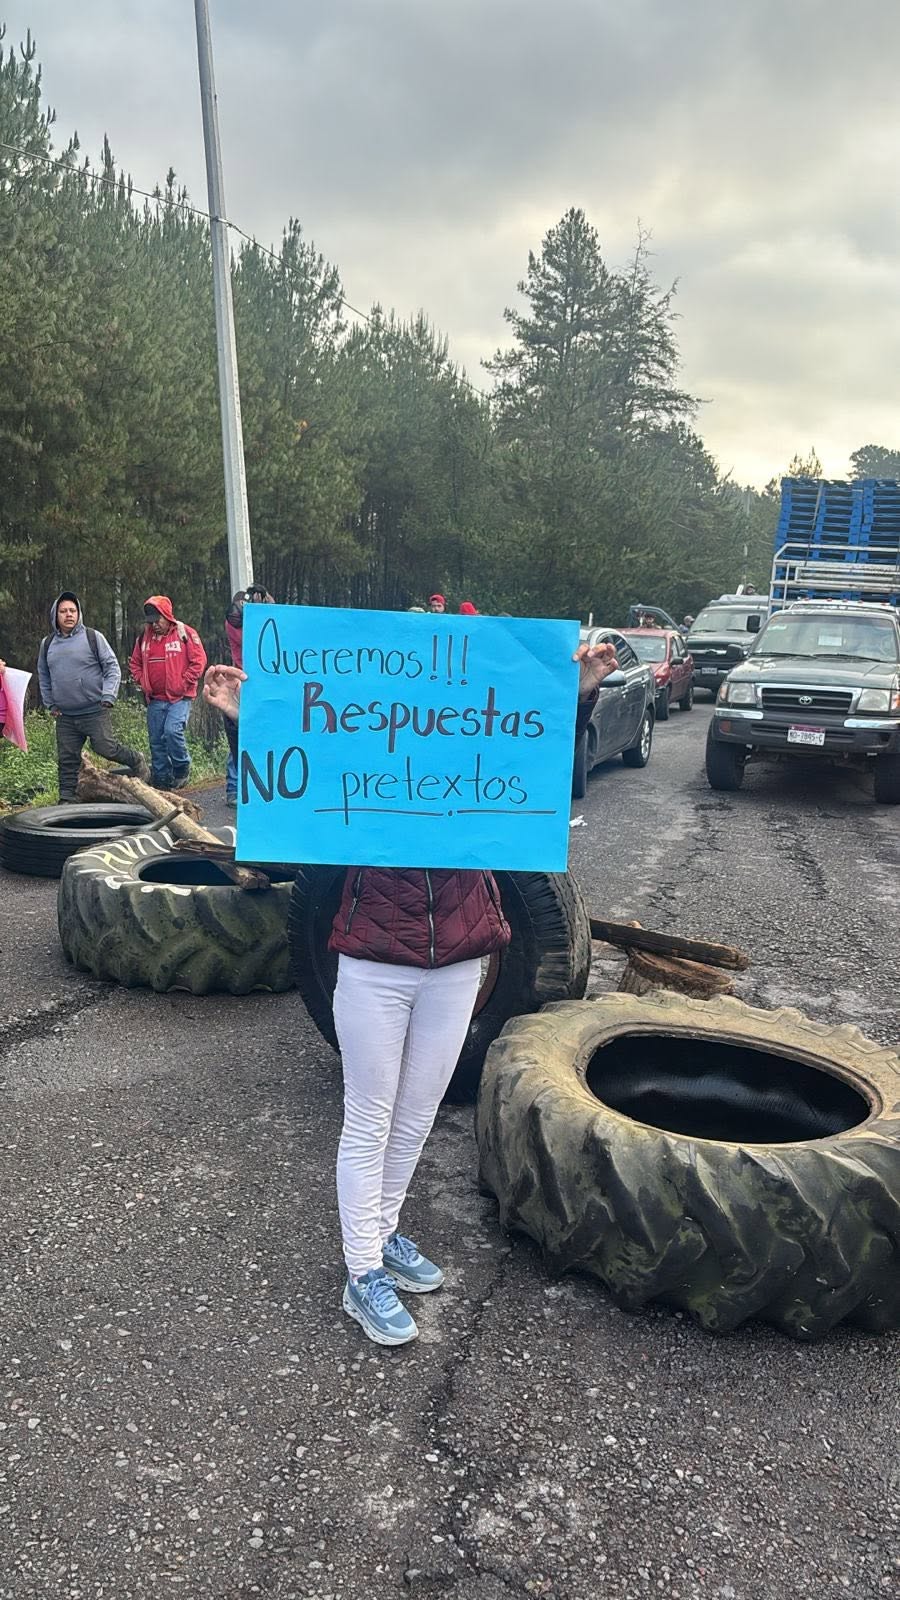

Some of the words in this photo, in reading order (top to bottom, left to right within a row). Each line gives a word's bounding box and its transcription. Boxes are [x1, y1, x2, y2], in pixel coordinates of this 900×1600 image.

[257, 617, 468, 686] Queremos!!!
[301, 681, 545, 754] Respuestas
[240, 746, 309, 805] NO
[341, 753, 528, 826] pretextos
